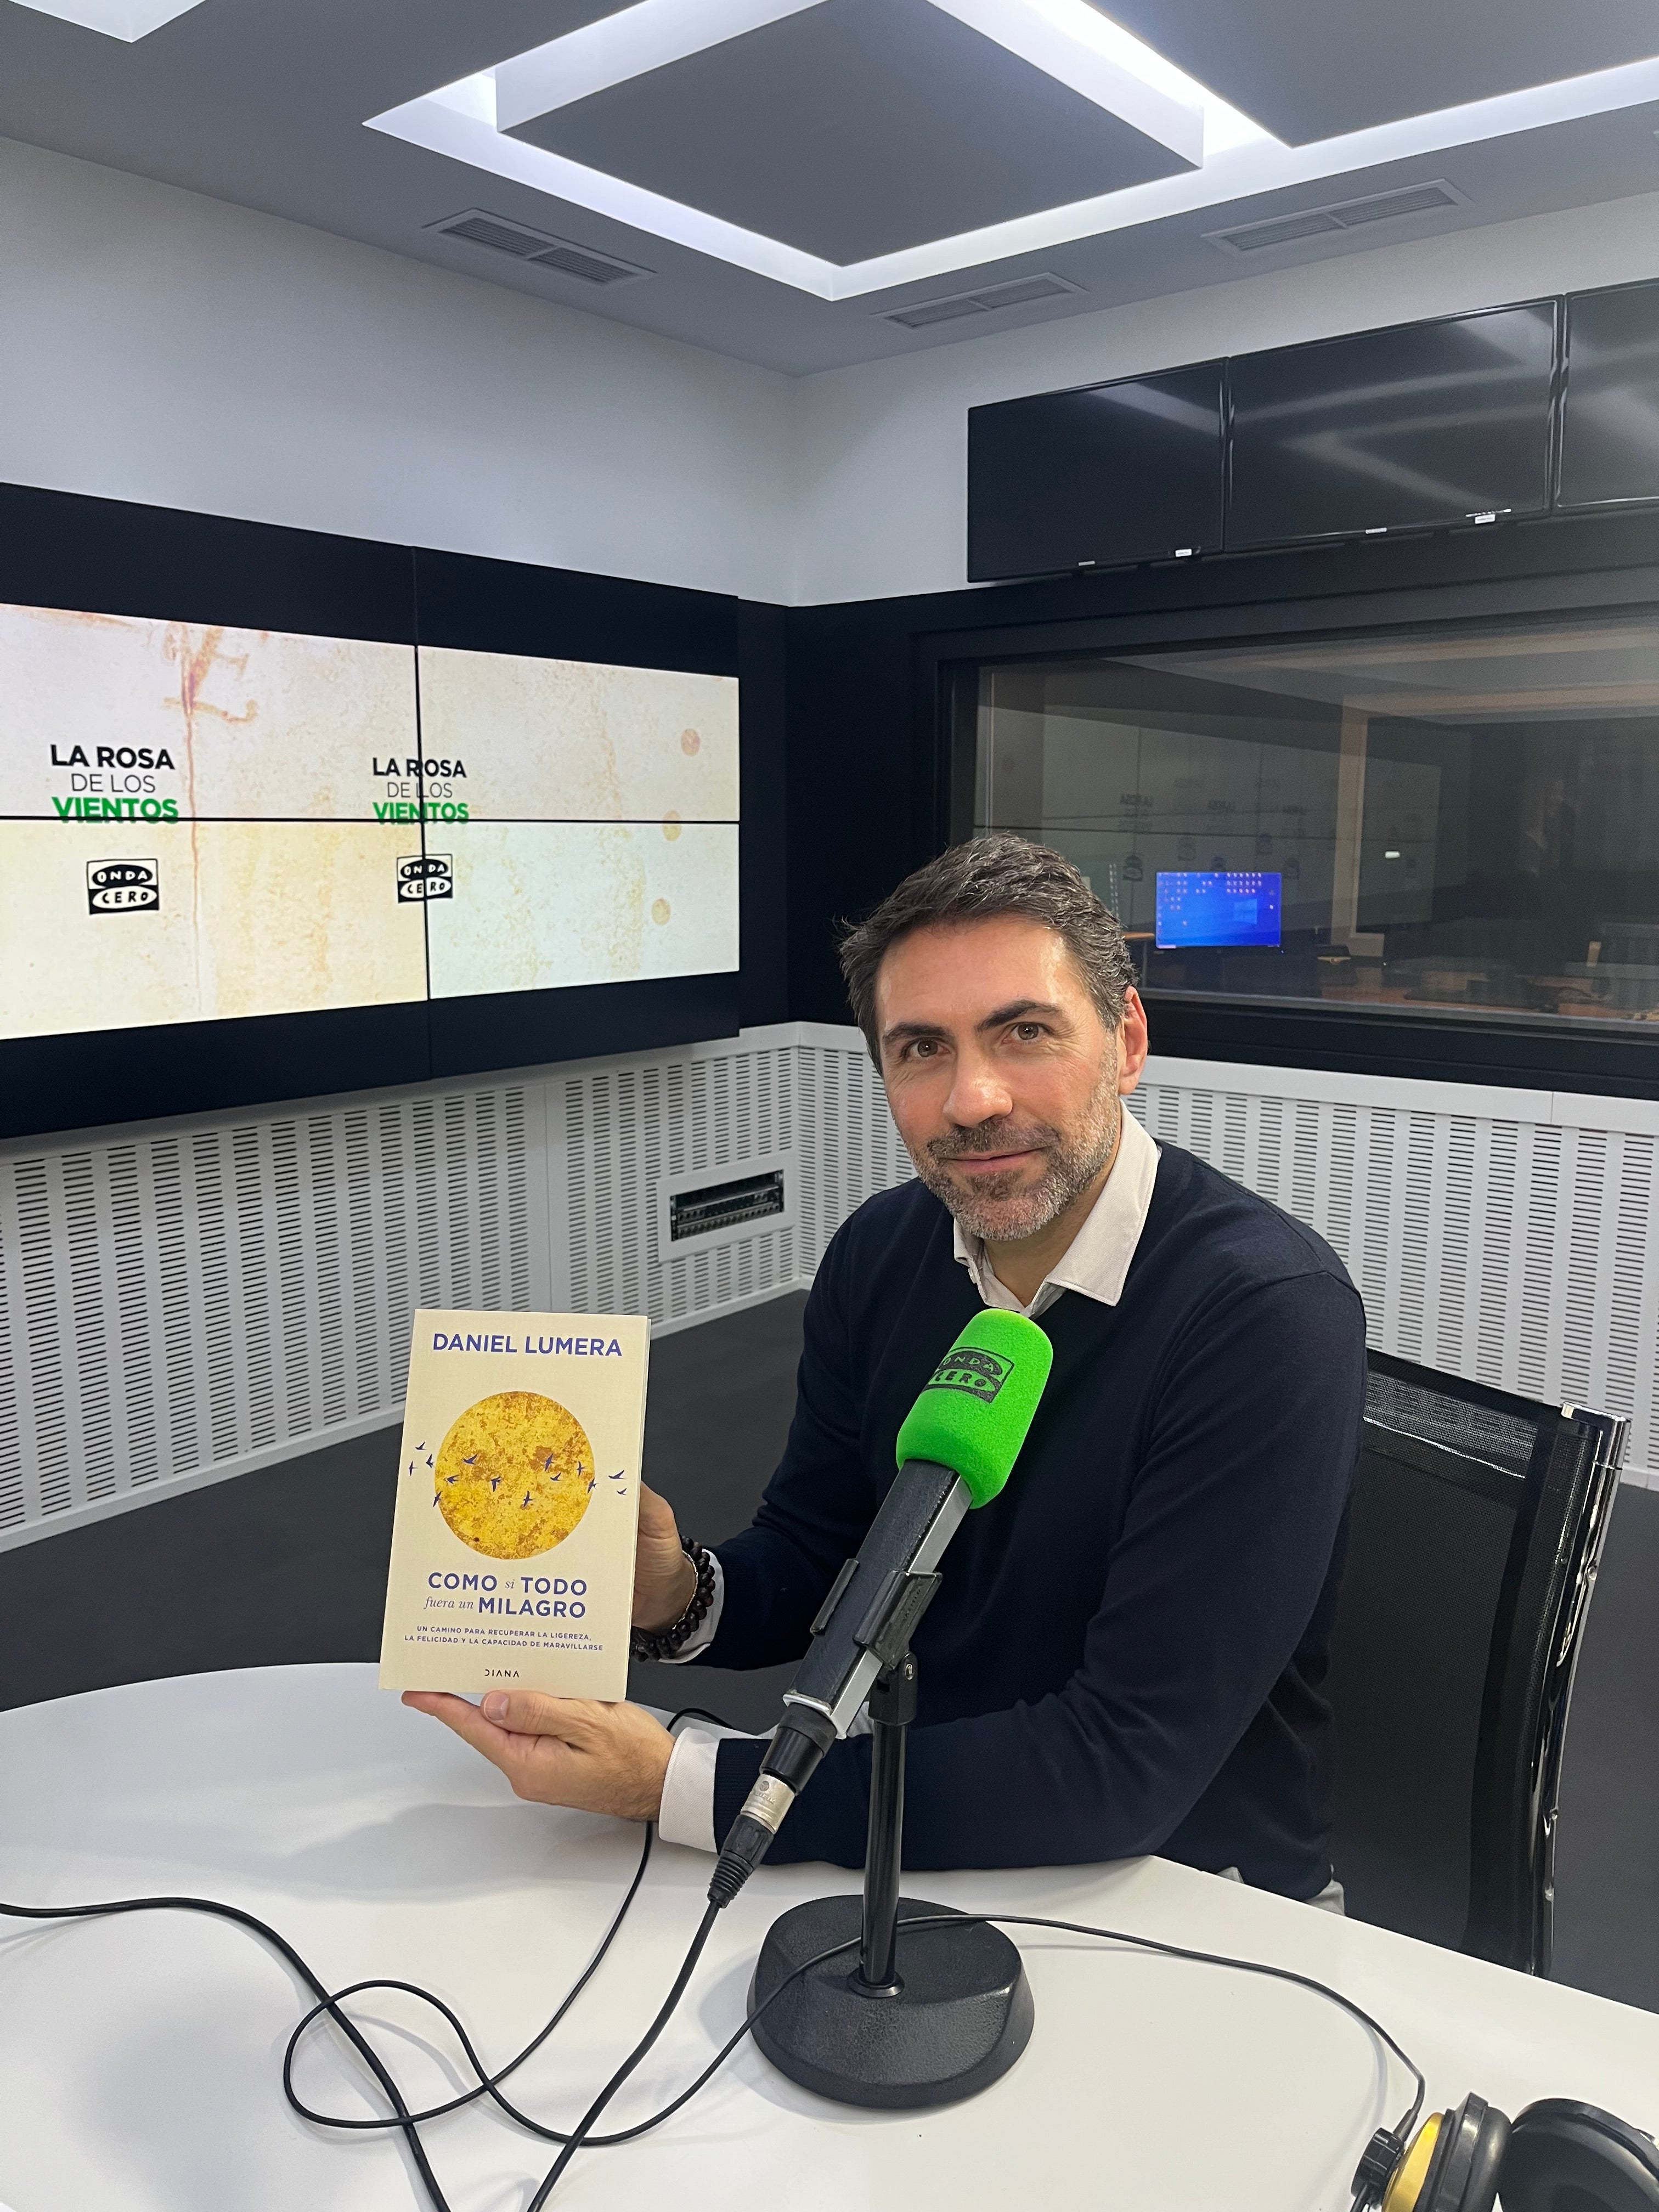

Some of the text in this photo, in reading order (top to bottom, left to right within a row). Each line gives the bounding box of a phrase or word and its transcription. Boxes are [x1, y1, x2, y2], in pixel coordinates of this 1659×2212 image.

[50, 744, 176, 770] LA ROSA
[373, 758, 467, 778] LA ROSA
[71, 773, 156, 793] DE LOS
[387, 782, 453, 798] DE LOS
[51, 796, 179, 824] VIENTOS
[372, 802, 470, 825] VIENTOS
[97, 870, 148, 883] ONDA
[403, 864, 445, 876] ONDA
[407, 882, 445, 894] CERO
[101, 891, 149, 904] CERO
[433, 1333, 623, 1357] DANIEL LUMERA
[943, 1356, 995, 1372] ONDA
[428, 1572, 587, 1596] COMO si TODO
[423, 1596, 585, 1618] fuera un MILAGRO
[488, 1629, 535, 1637] RECUPERAR
[550, 1632, 591, 1641] LIGEREZA,
[543, 1642, 603, 1651] MARAVILLARSE
